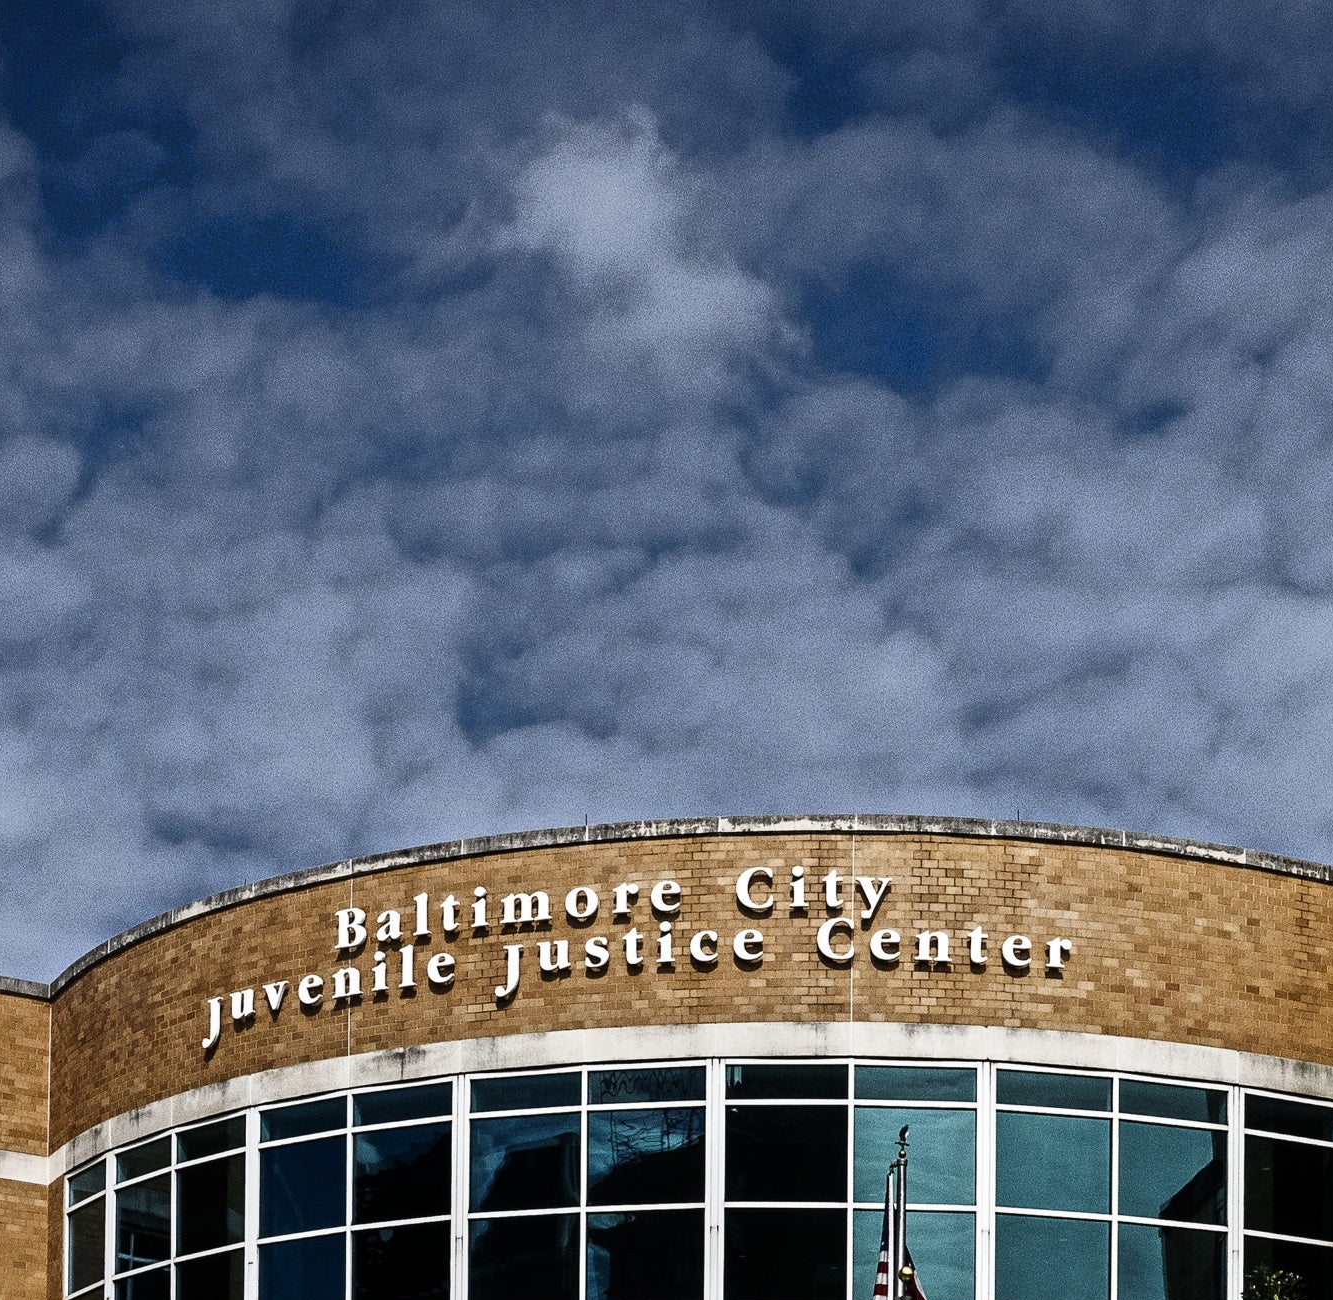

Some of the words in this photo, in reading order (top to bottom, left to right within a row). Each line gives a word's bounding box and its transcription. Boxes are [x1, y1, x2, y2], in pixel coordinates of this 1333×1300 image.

[334, 878, 682, 950] Baltimore
[736, 866, 892, 919] City
[202, 945, 456, 1050] Juvenile
[495, 920, 764, 999] Justice
[817, 917, 1073, 969] Center
